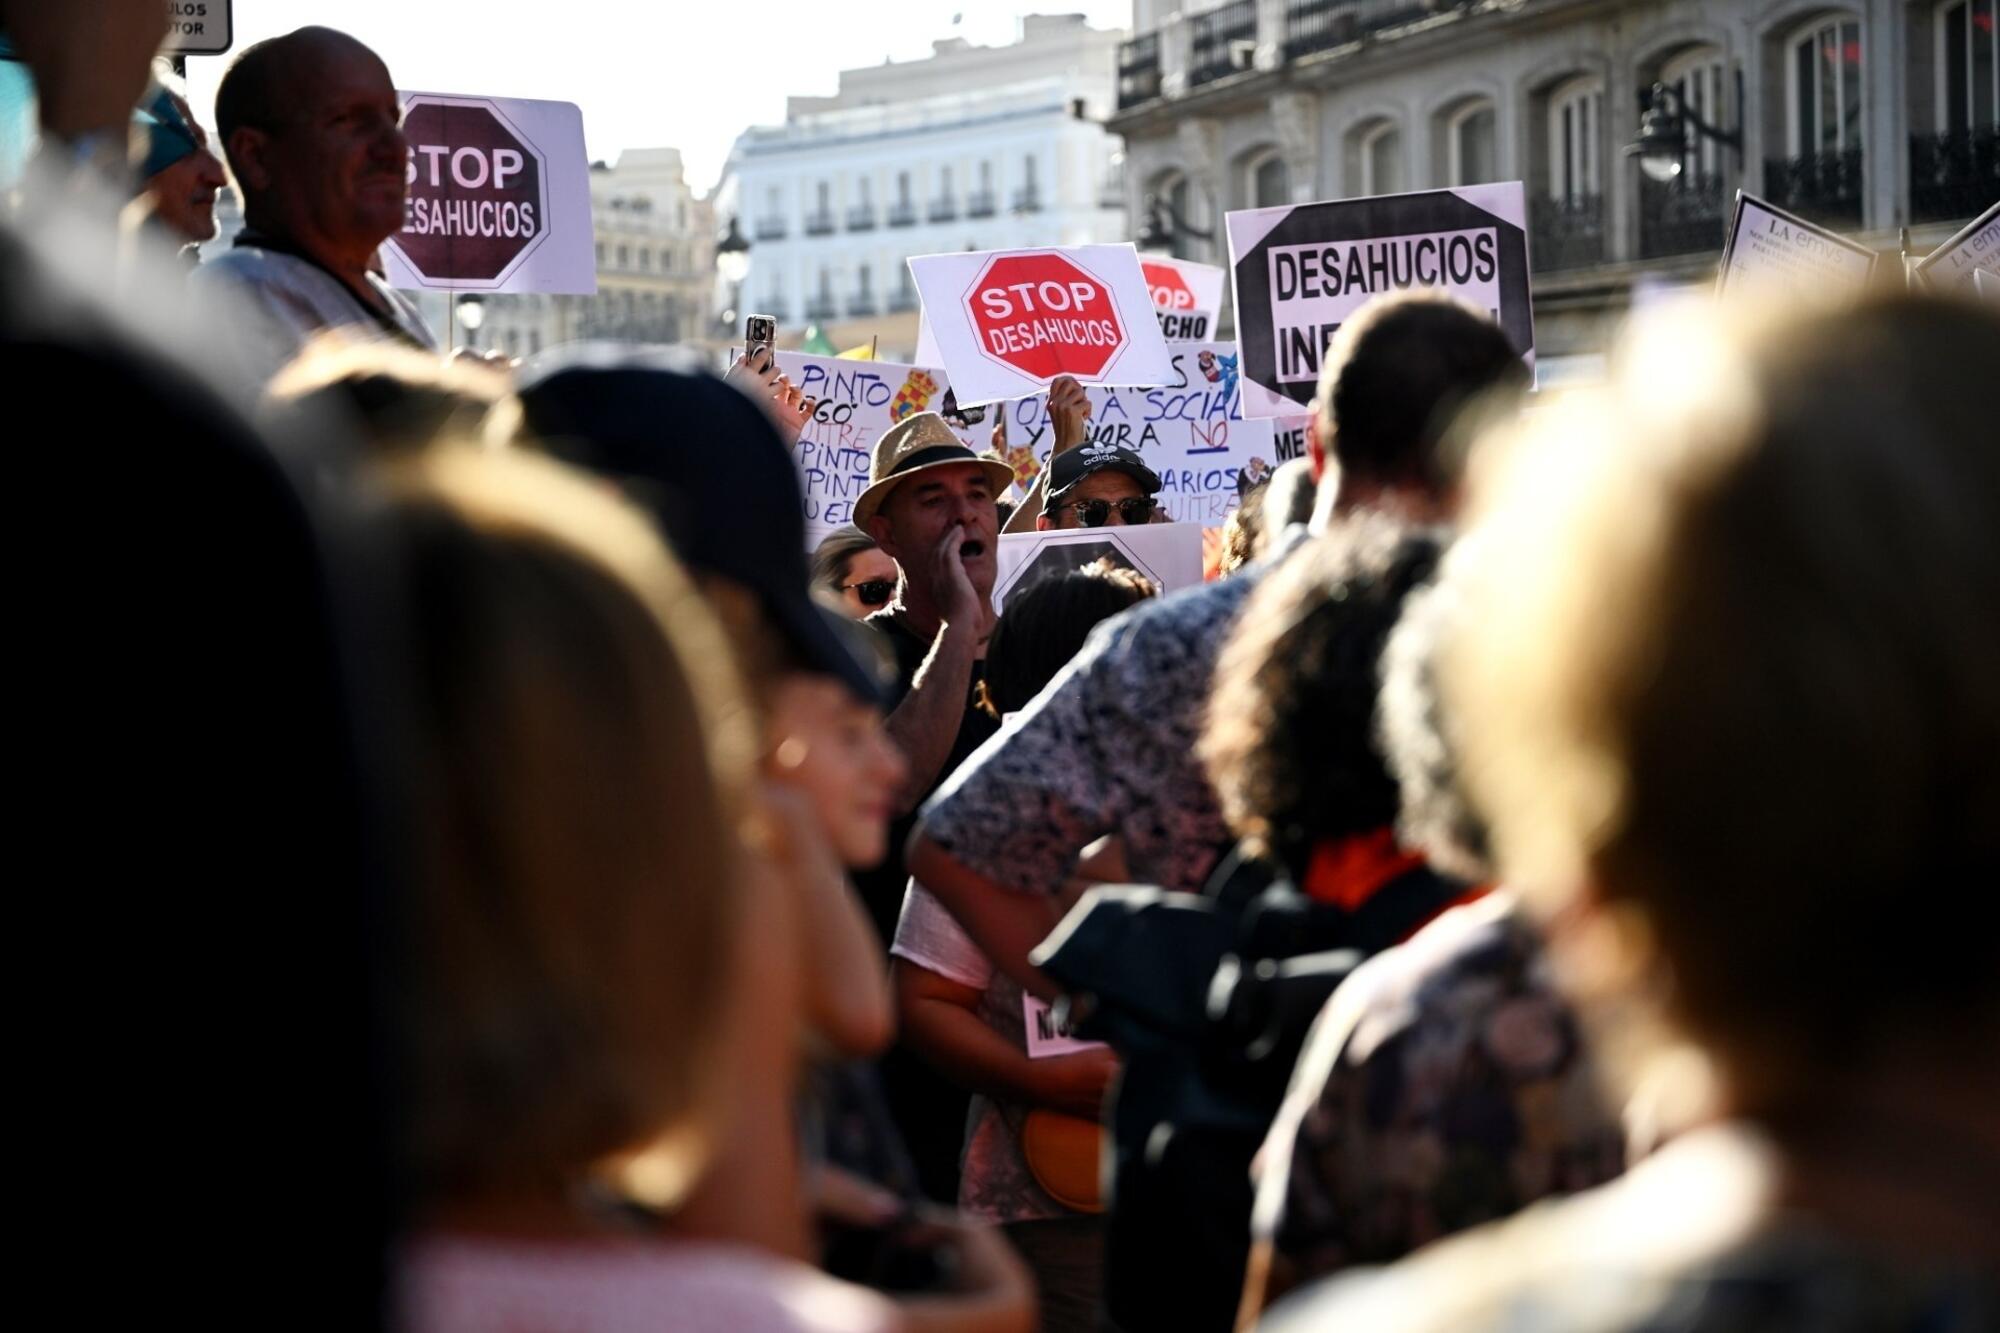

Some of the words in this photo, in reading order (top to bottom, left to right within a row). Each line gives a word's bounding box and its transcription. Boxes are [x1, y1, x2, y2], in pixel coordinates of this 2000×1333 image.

[402, 197, 535, 238] ESAHUCIOS
[1275, 232, 1496, 301] DESAHUCIOS
[981, 281, 1095, 319] STOP
[1149, 285, 1191, 309] OP
[989, 318, 1118, 356] DESAHUCIOS
[1157, 312, 1207, 339] CHO
[800, 421, 872, 449] UITRE
[1025, 425, 1045, 446] Y
[1190, 421, 1228, 448] NO
[1160, 493, 1240, 522] UITRE
